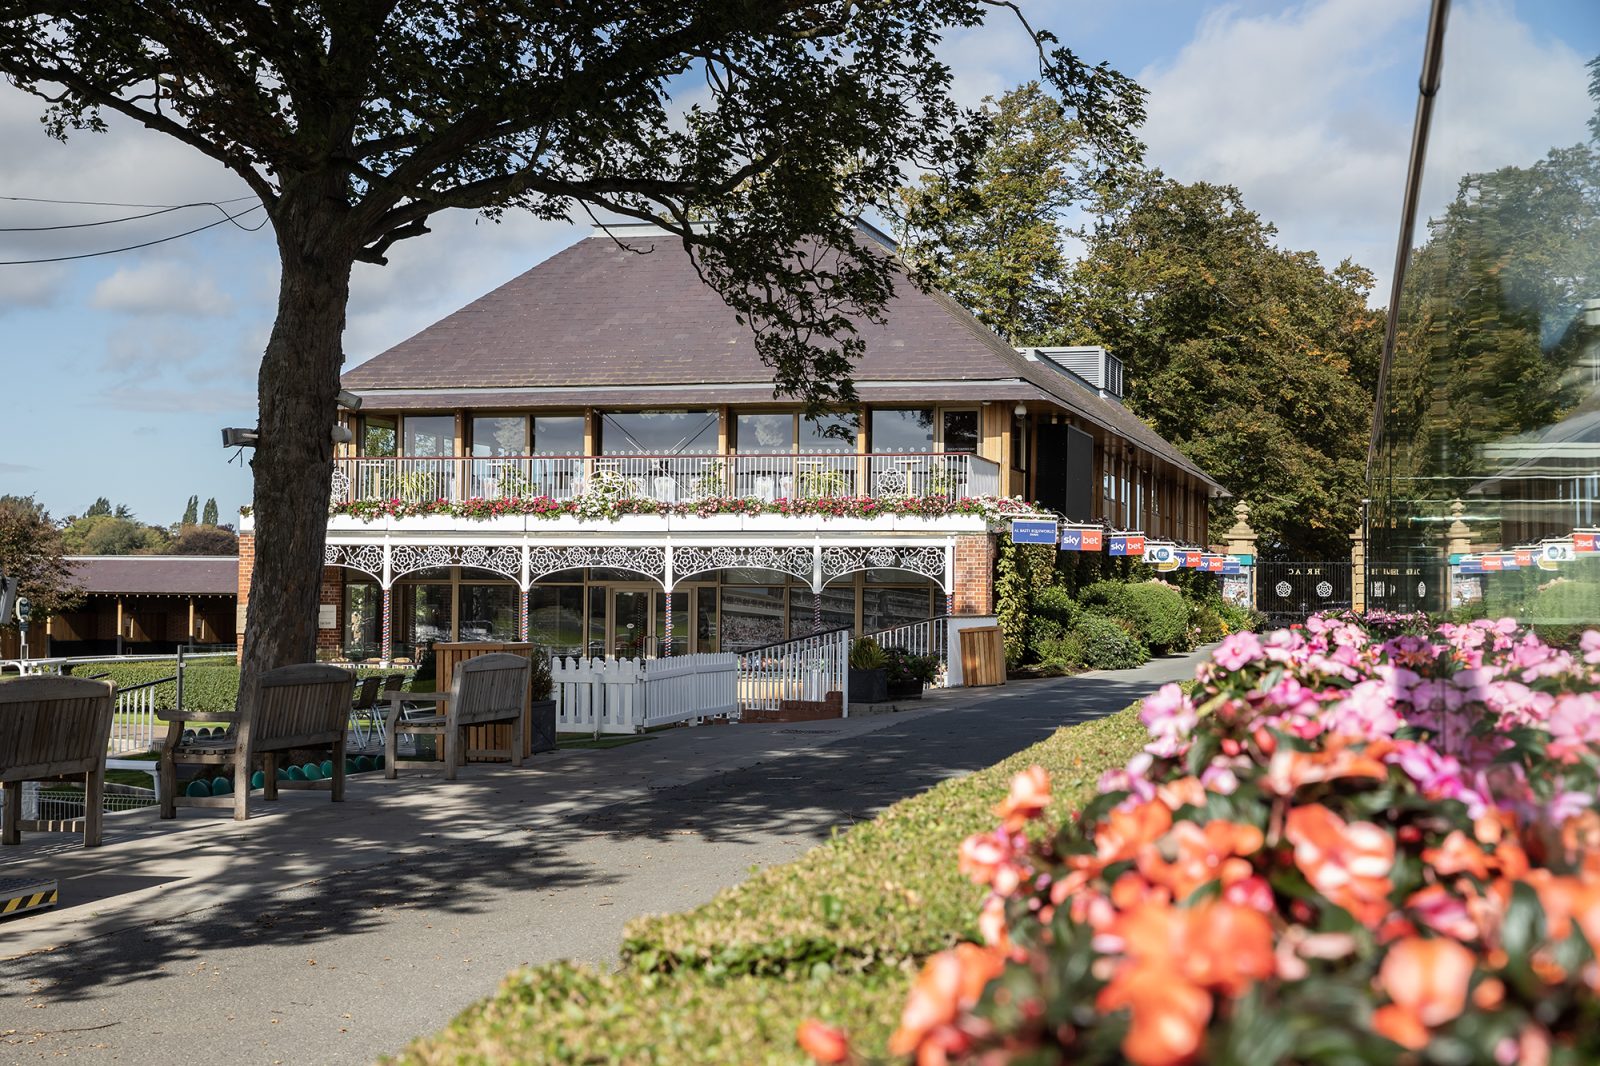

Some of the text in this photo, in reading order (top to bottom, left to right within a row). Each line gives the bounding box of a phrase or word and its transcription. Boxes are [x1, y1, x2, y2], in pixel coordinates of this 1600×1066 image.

[1063, 535, 1099, 546] sky bet
[1110, 542, 1142, 551] sky bet
[1187, 555, 1200, 563] bet
